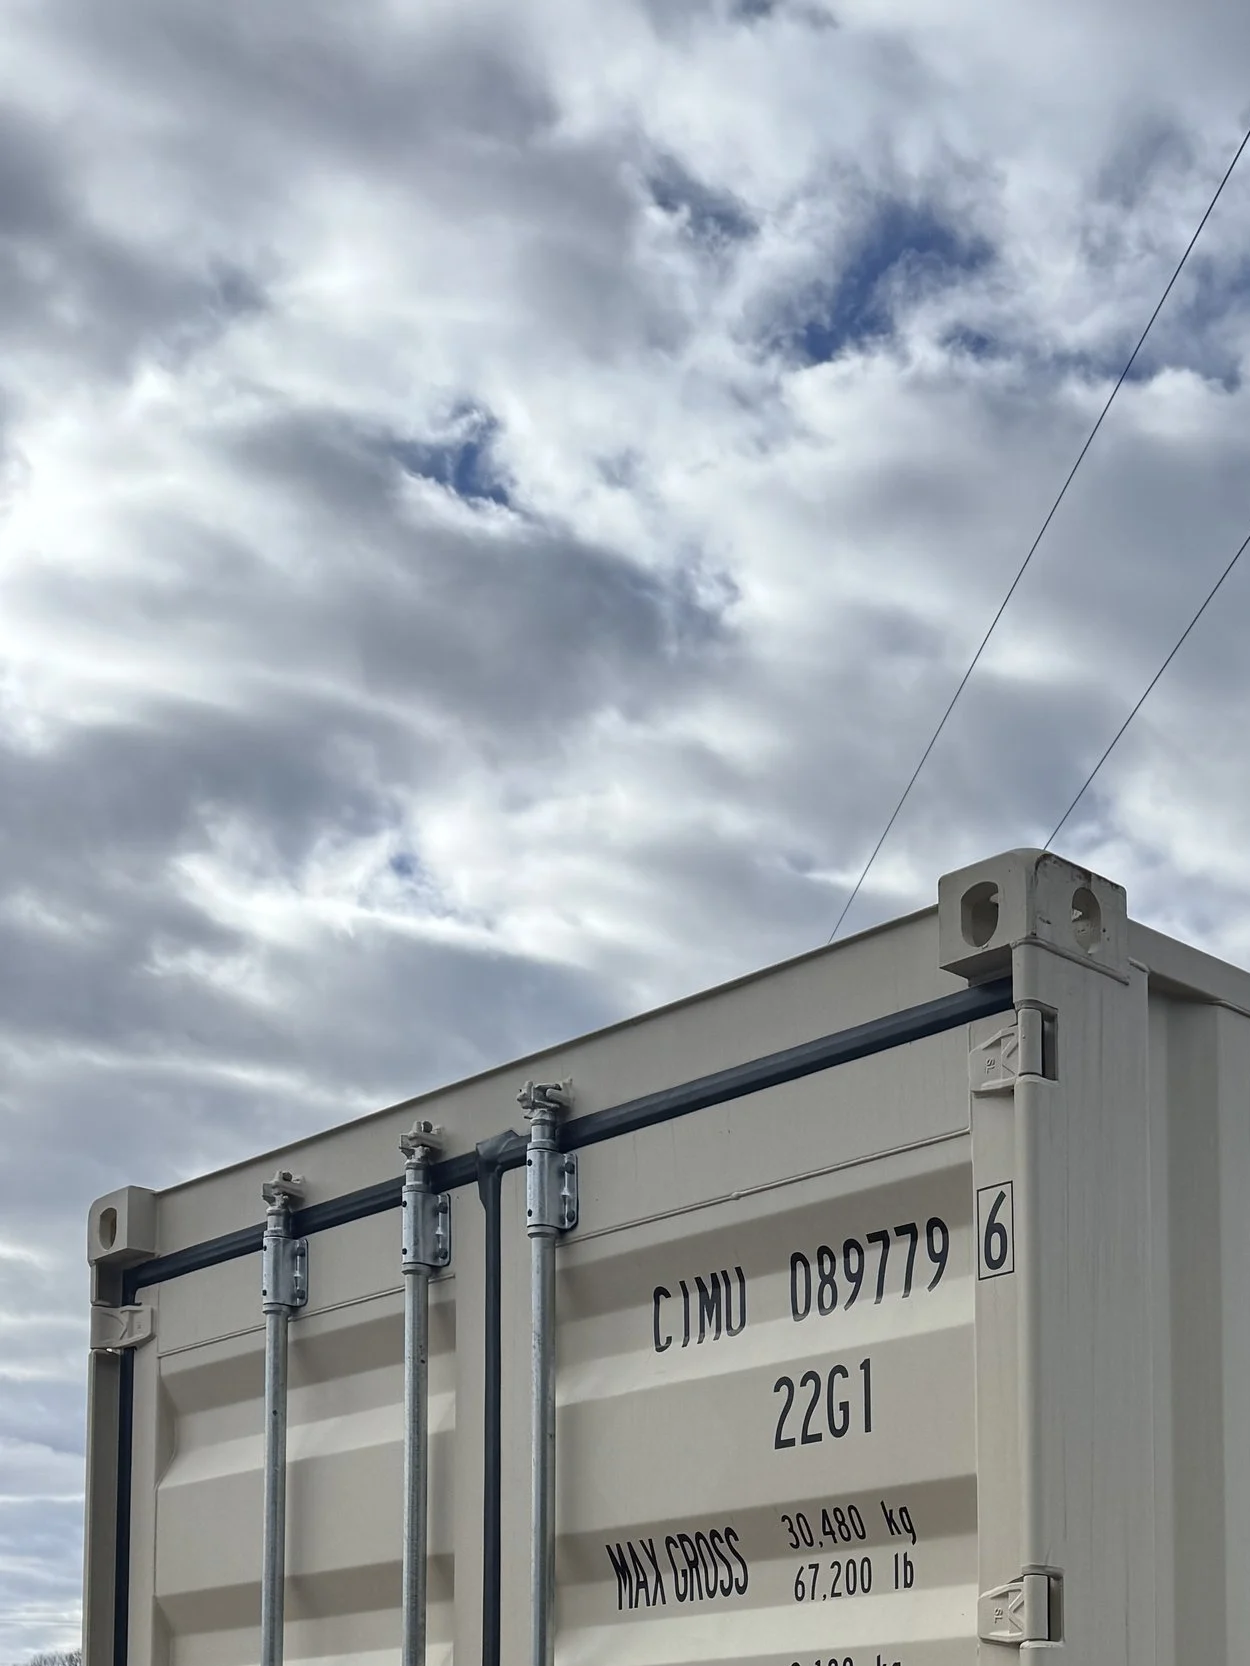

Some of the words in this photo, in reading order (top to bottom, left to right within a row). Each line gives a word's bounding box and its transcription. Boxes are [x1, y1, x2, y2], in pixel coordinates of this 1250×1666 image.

[653, 1266, 747, 1353] CIMU
[789, 1216, 950, 1323] 089779
[984, 1190, 1008, 1271] 6
[773, 1358, 872, 1450] 22G1
[606, 1539, 667, 1611] MAX
[665, 1526, 749, 1603] GROSS
[781, 1504, 867, 1550] 30,480
[880, 1499, 918, 1545] kg
[793, 1556, 873, 1603] 67,200
[894, 1552, 914, 1590] lb
